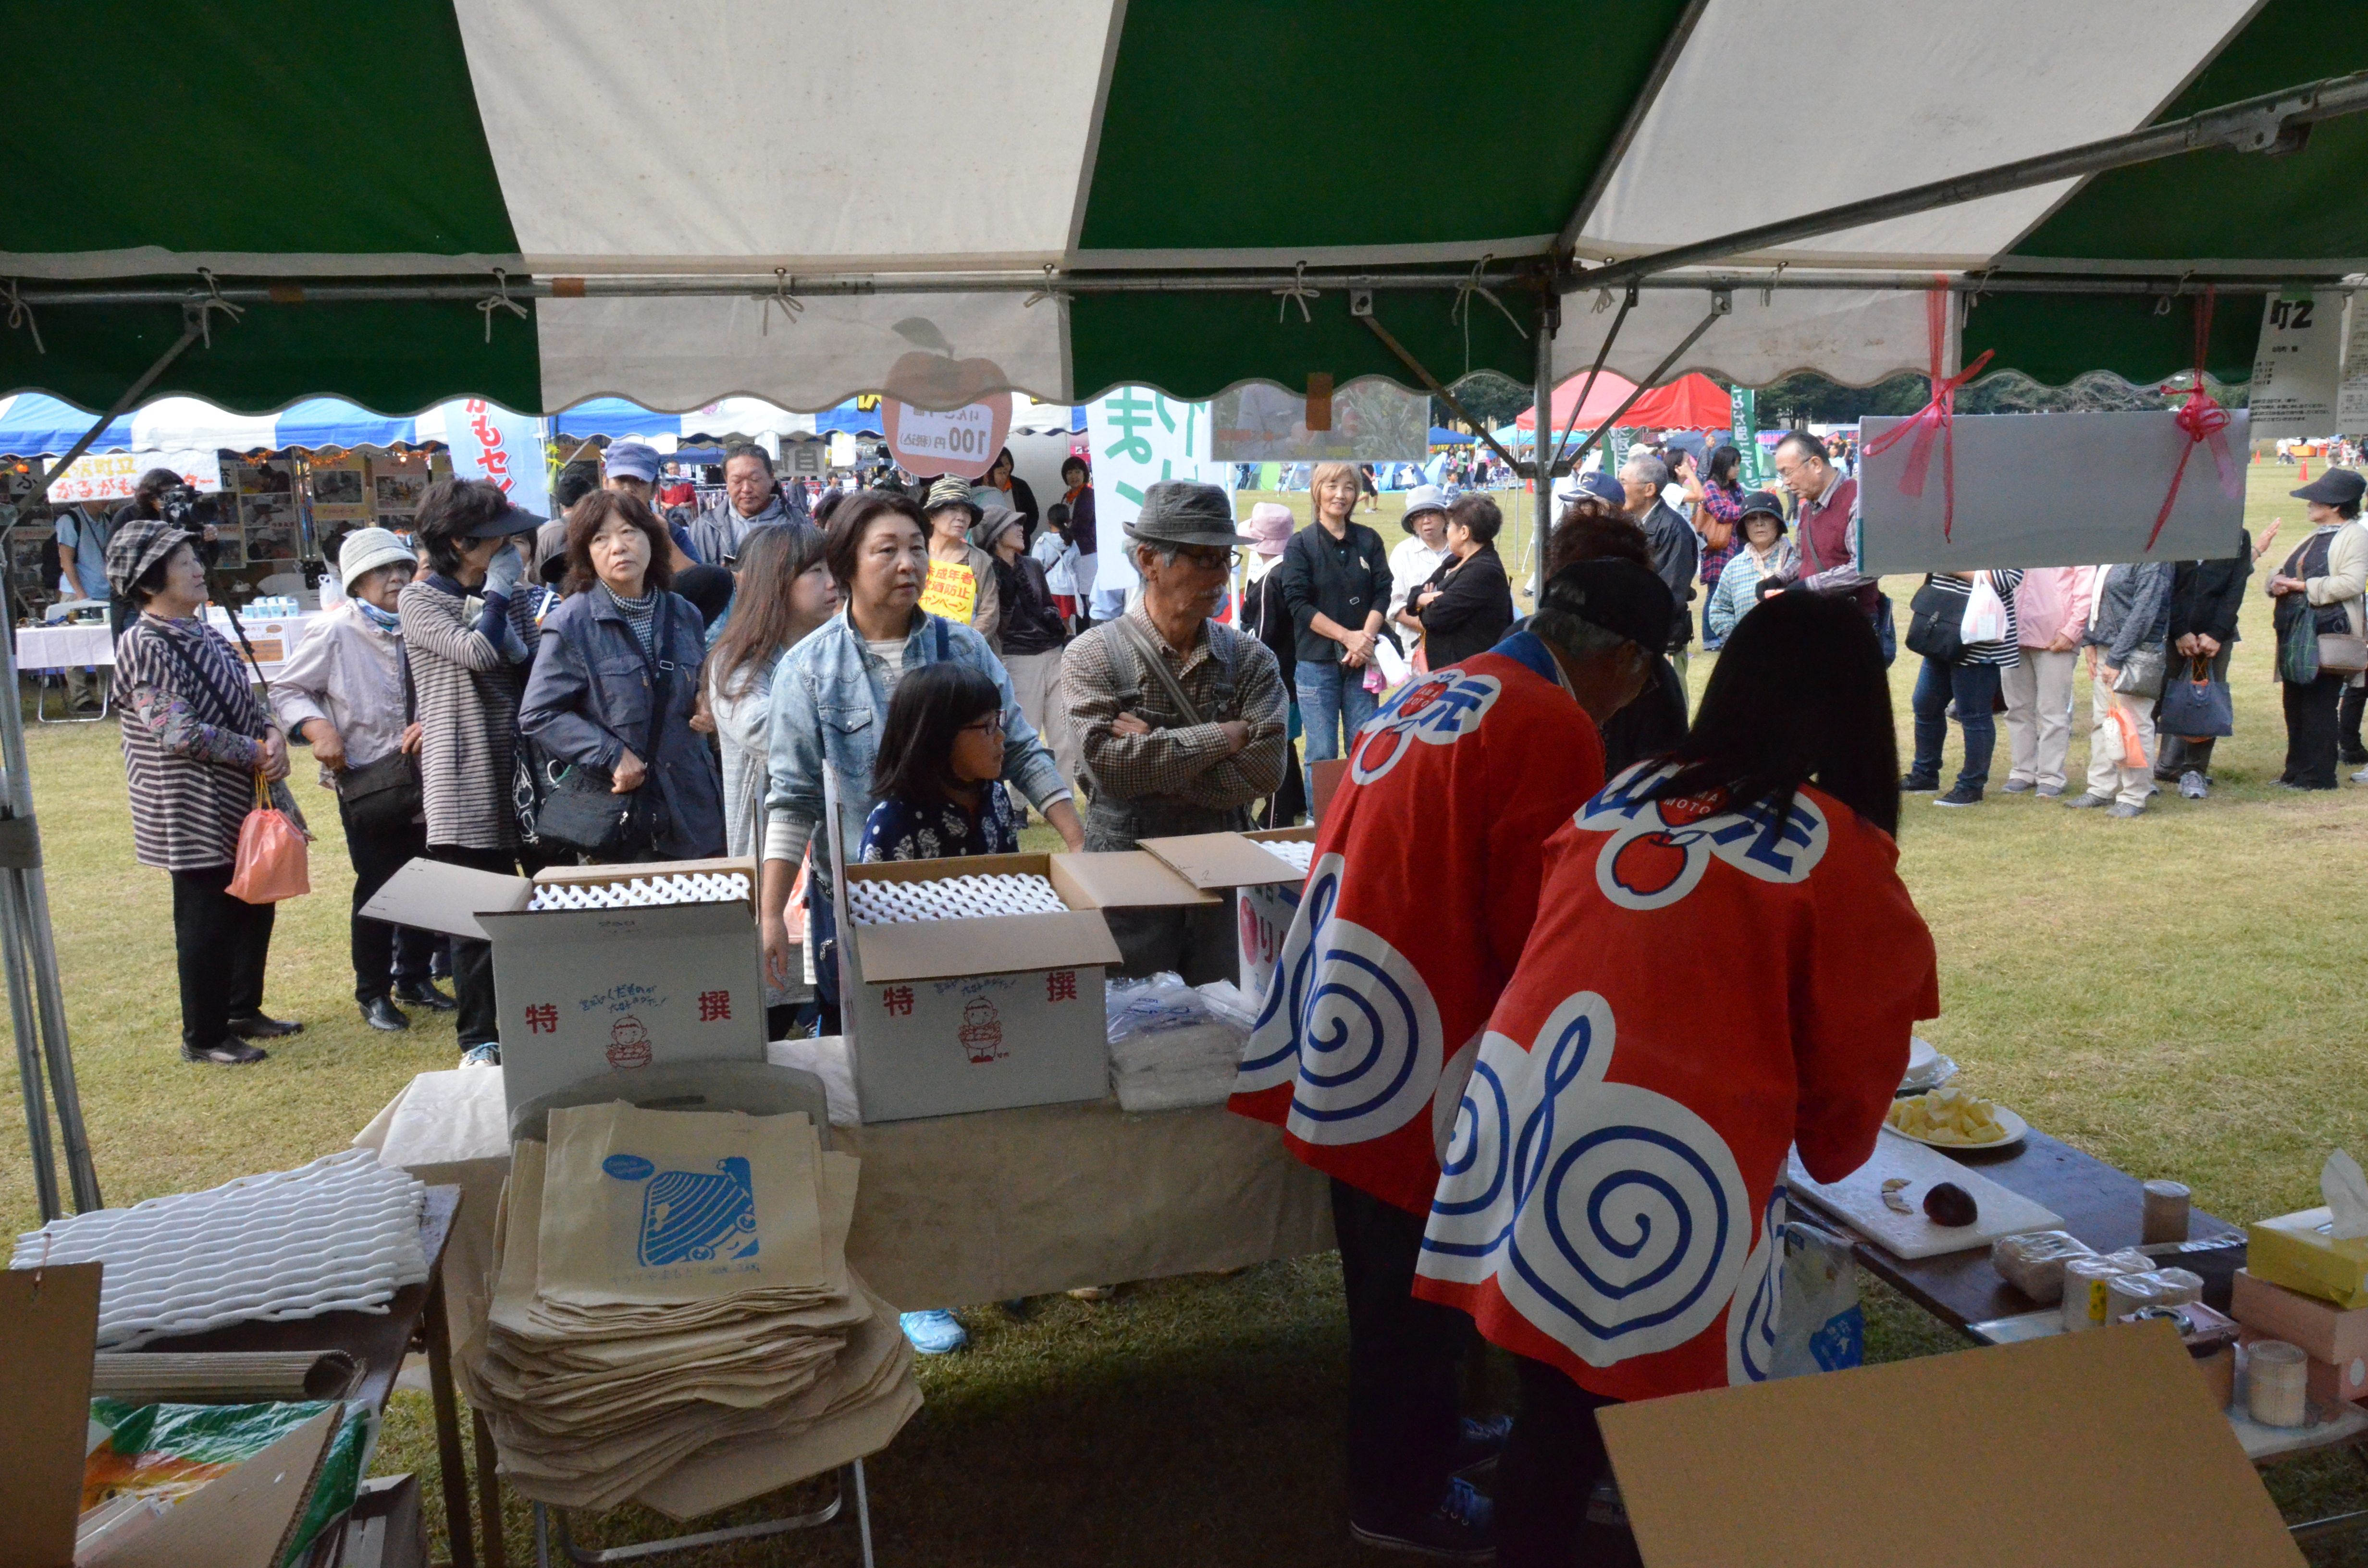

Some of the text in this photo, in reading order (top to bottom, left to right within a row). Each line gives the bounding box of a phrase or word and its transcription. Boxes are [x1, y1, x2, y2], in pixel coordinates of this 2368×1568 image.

[1663, 797, 1712, 814] MOTO
[883, 985, 914, 1017] 特
[525, 1003, 559, 1034] 特
